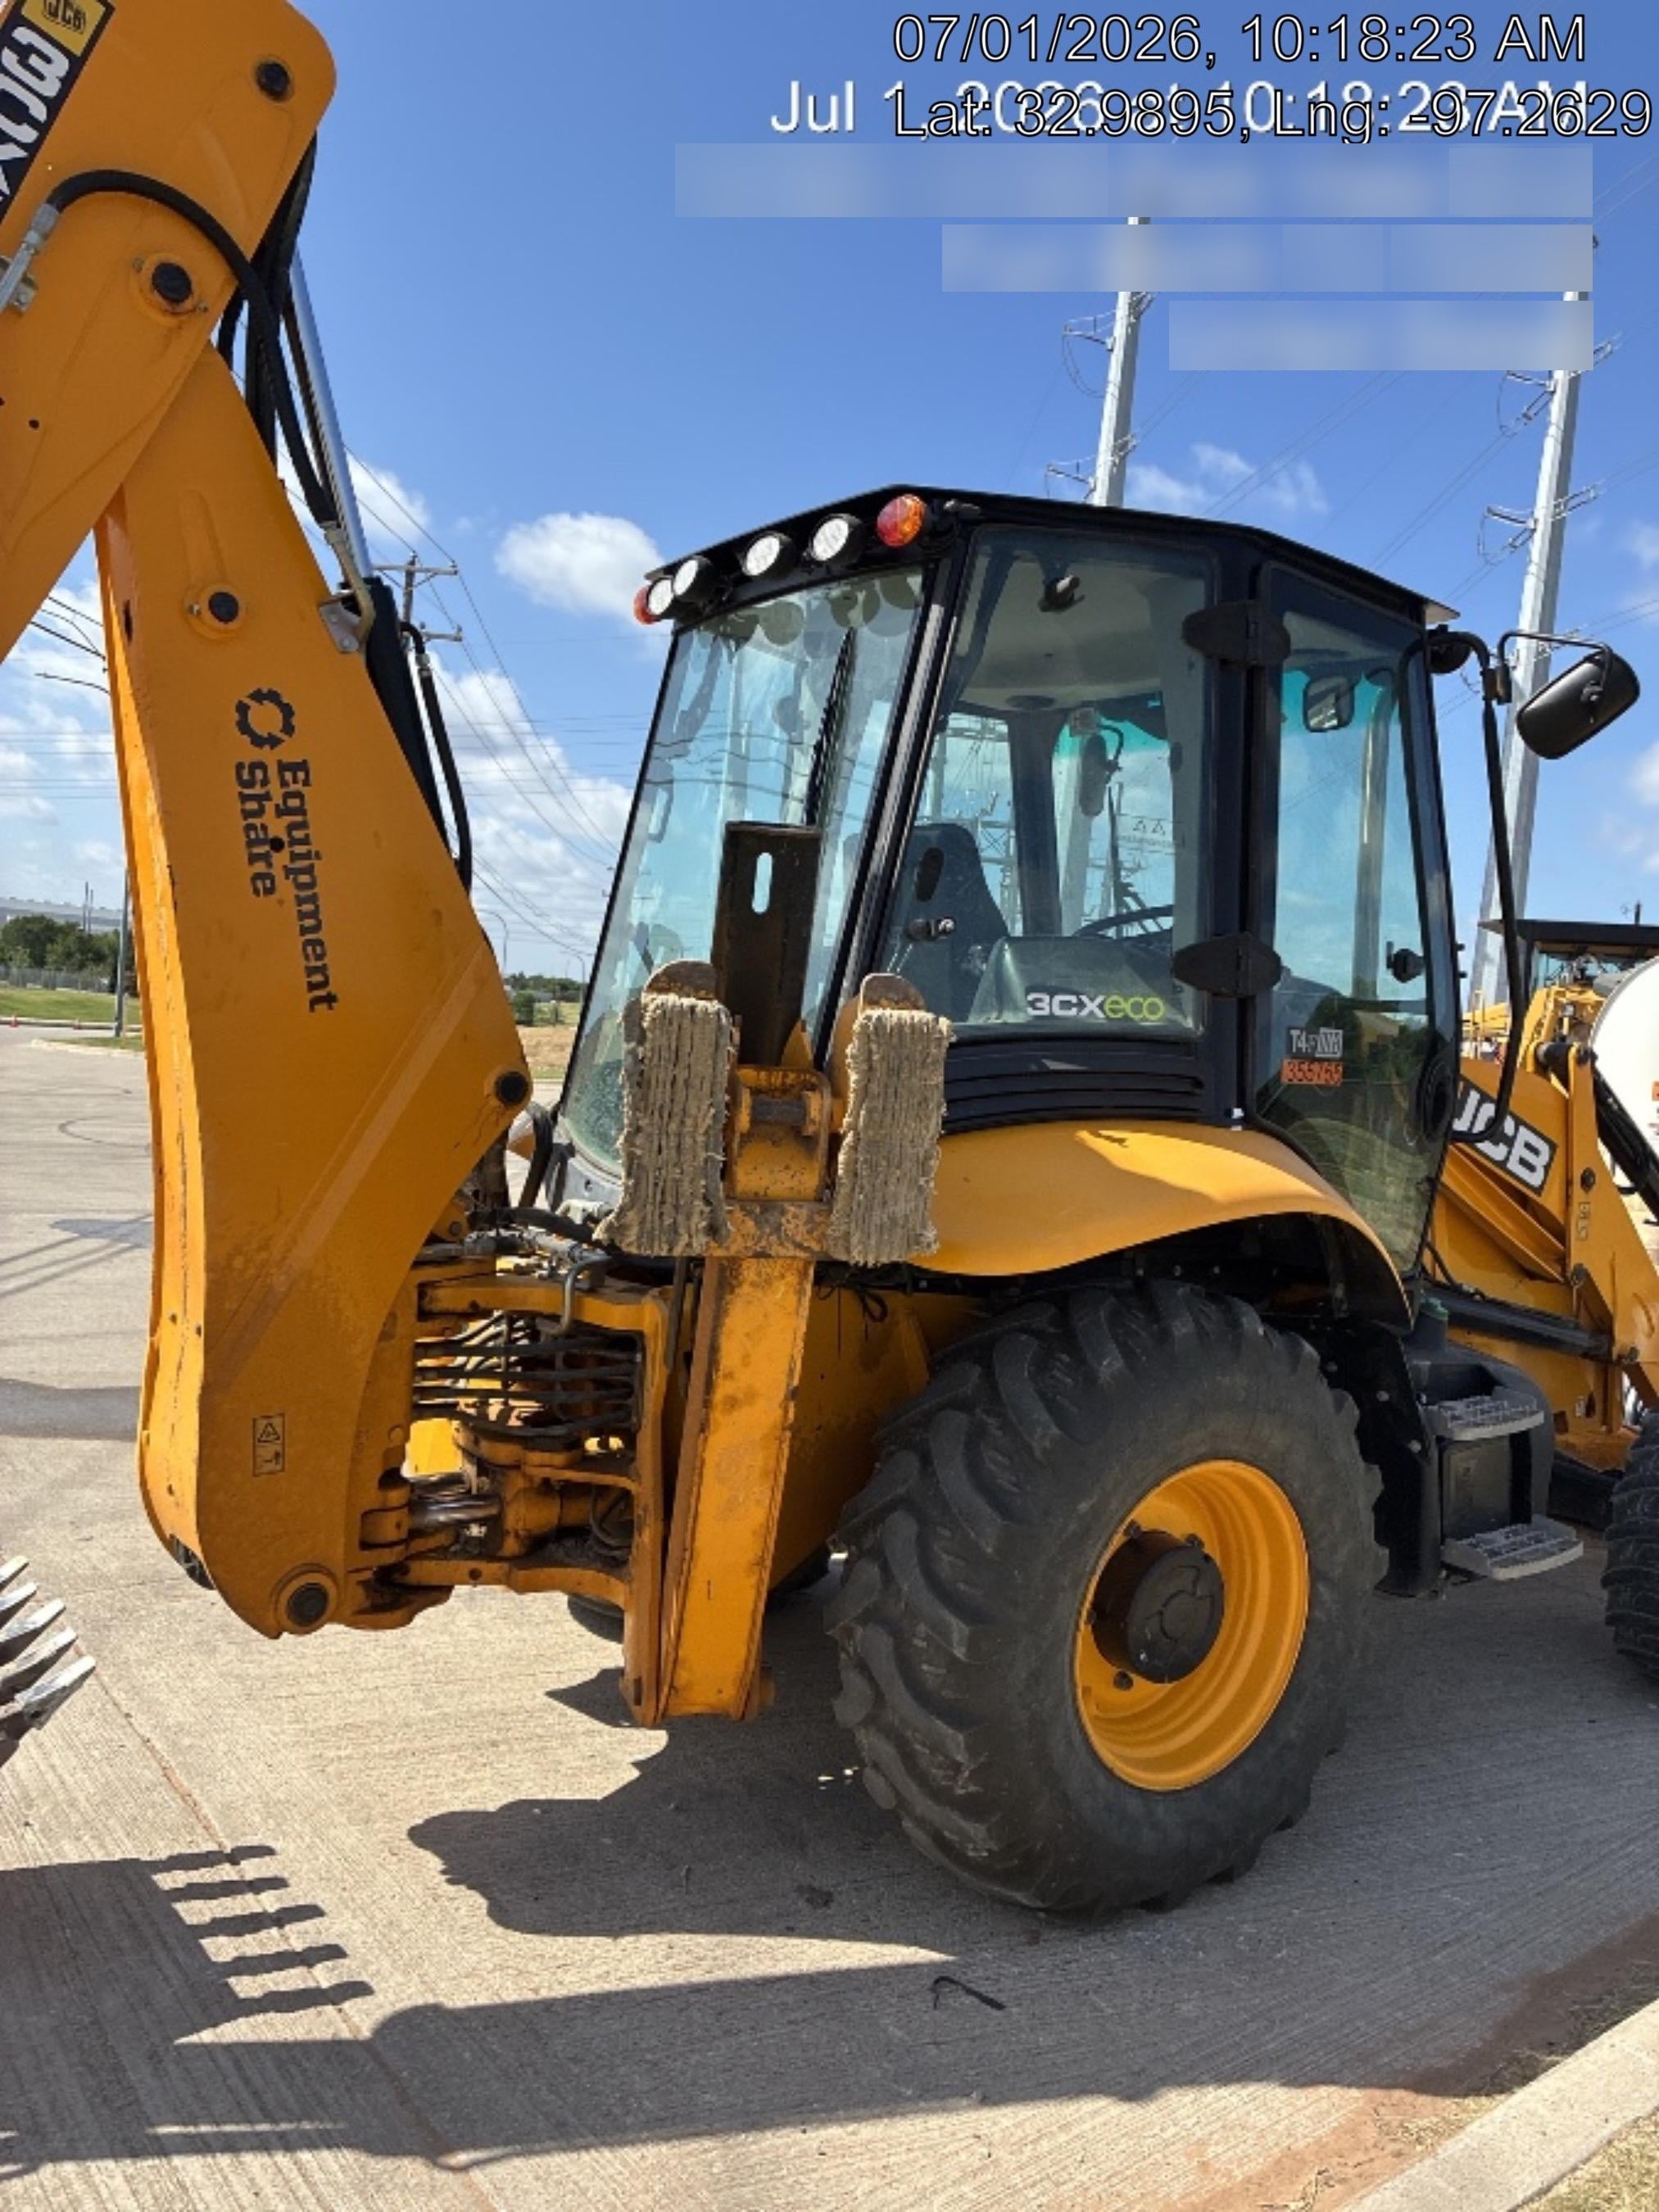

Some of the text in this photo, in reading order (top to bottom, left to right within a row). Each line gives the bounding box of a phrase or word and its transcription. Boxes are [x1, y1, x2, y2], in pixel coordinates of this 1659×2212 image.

[234, 759, 278, 899] Share
[274, 758, 339, 1014] Equipment
[1453, 1089, 1551, 1188] JCB
